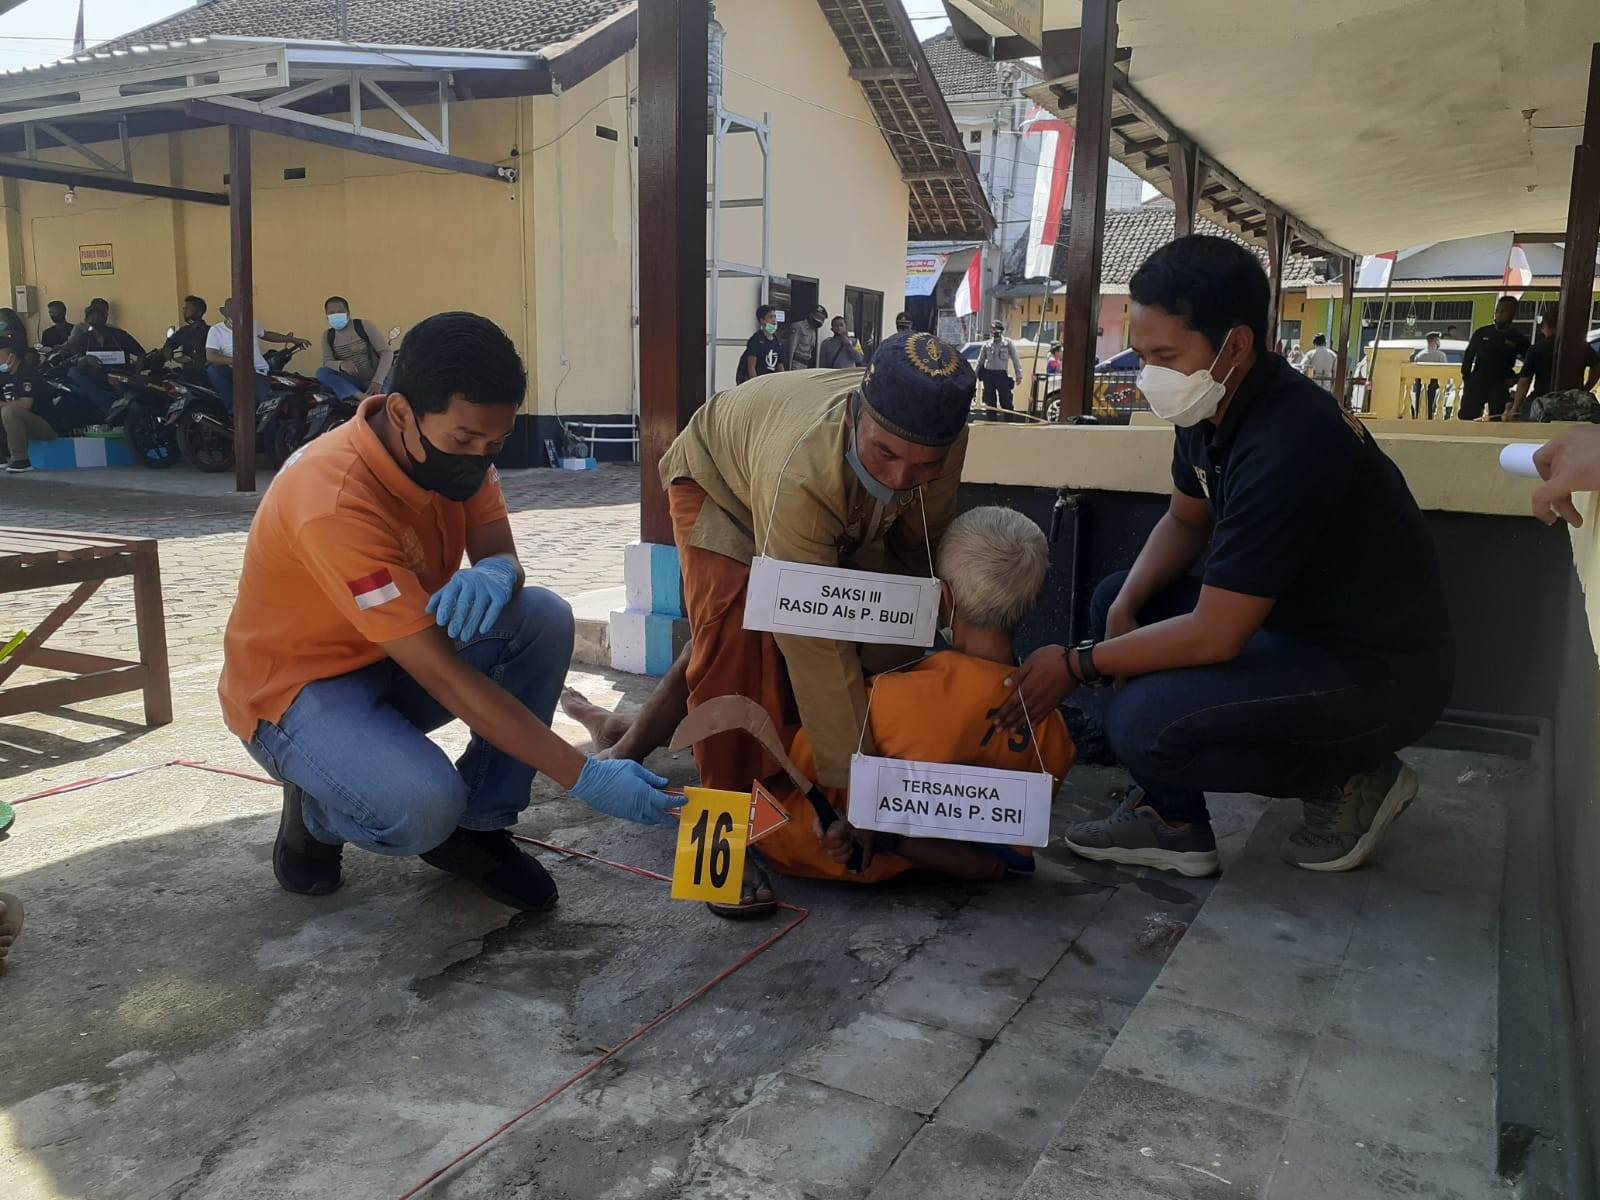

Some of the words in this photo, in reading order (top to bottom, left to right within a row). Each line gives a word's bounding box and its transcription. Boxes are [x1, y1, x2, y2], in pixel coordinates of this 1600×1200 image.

[820, 585, 866, 602] SAKSI
[869, 590, 882, 604] III
[779, 597, 829, 616] RASID
[831, 604, 857, 620] Als
[860, 607, 876, 622] P.
[879, 609, 914, 626] BUDI
[901, 779, 1000, 801] TERSANGKA
[878, 796, 929, 816] ASAN
[934, 802, 963, 819] Als
[968, 804, 986, 821] P.
[991, 807, 1022, 825] SRI
[691, 809, 734, 889] 16
